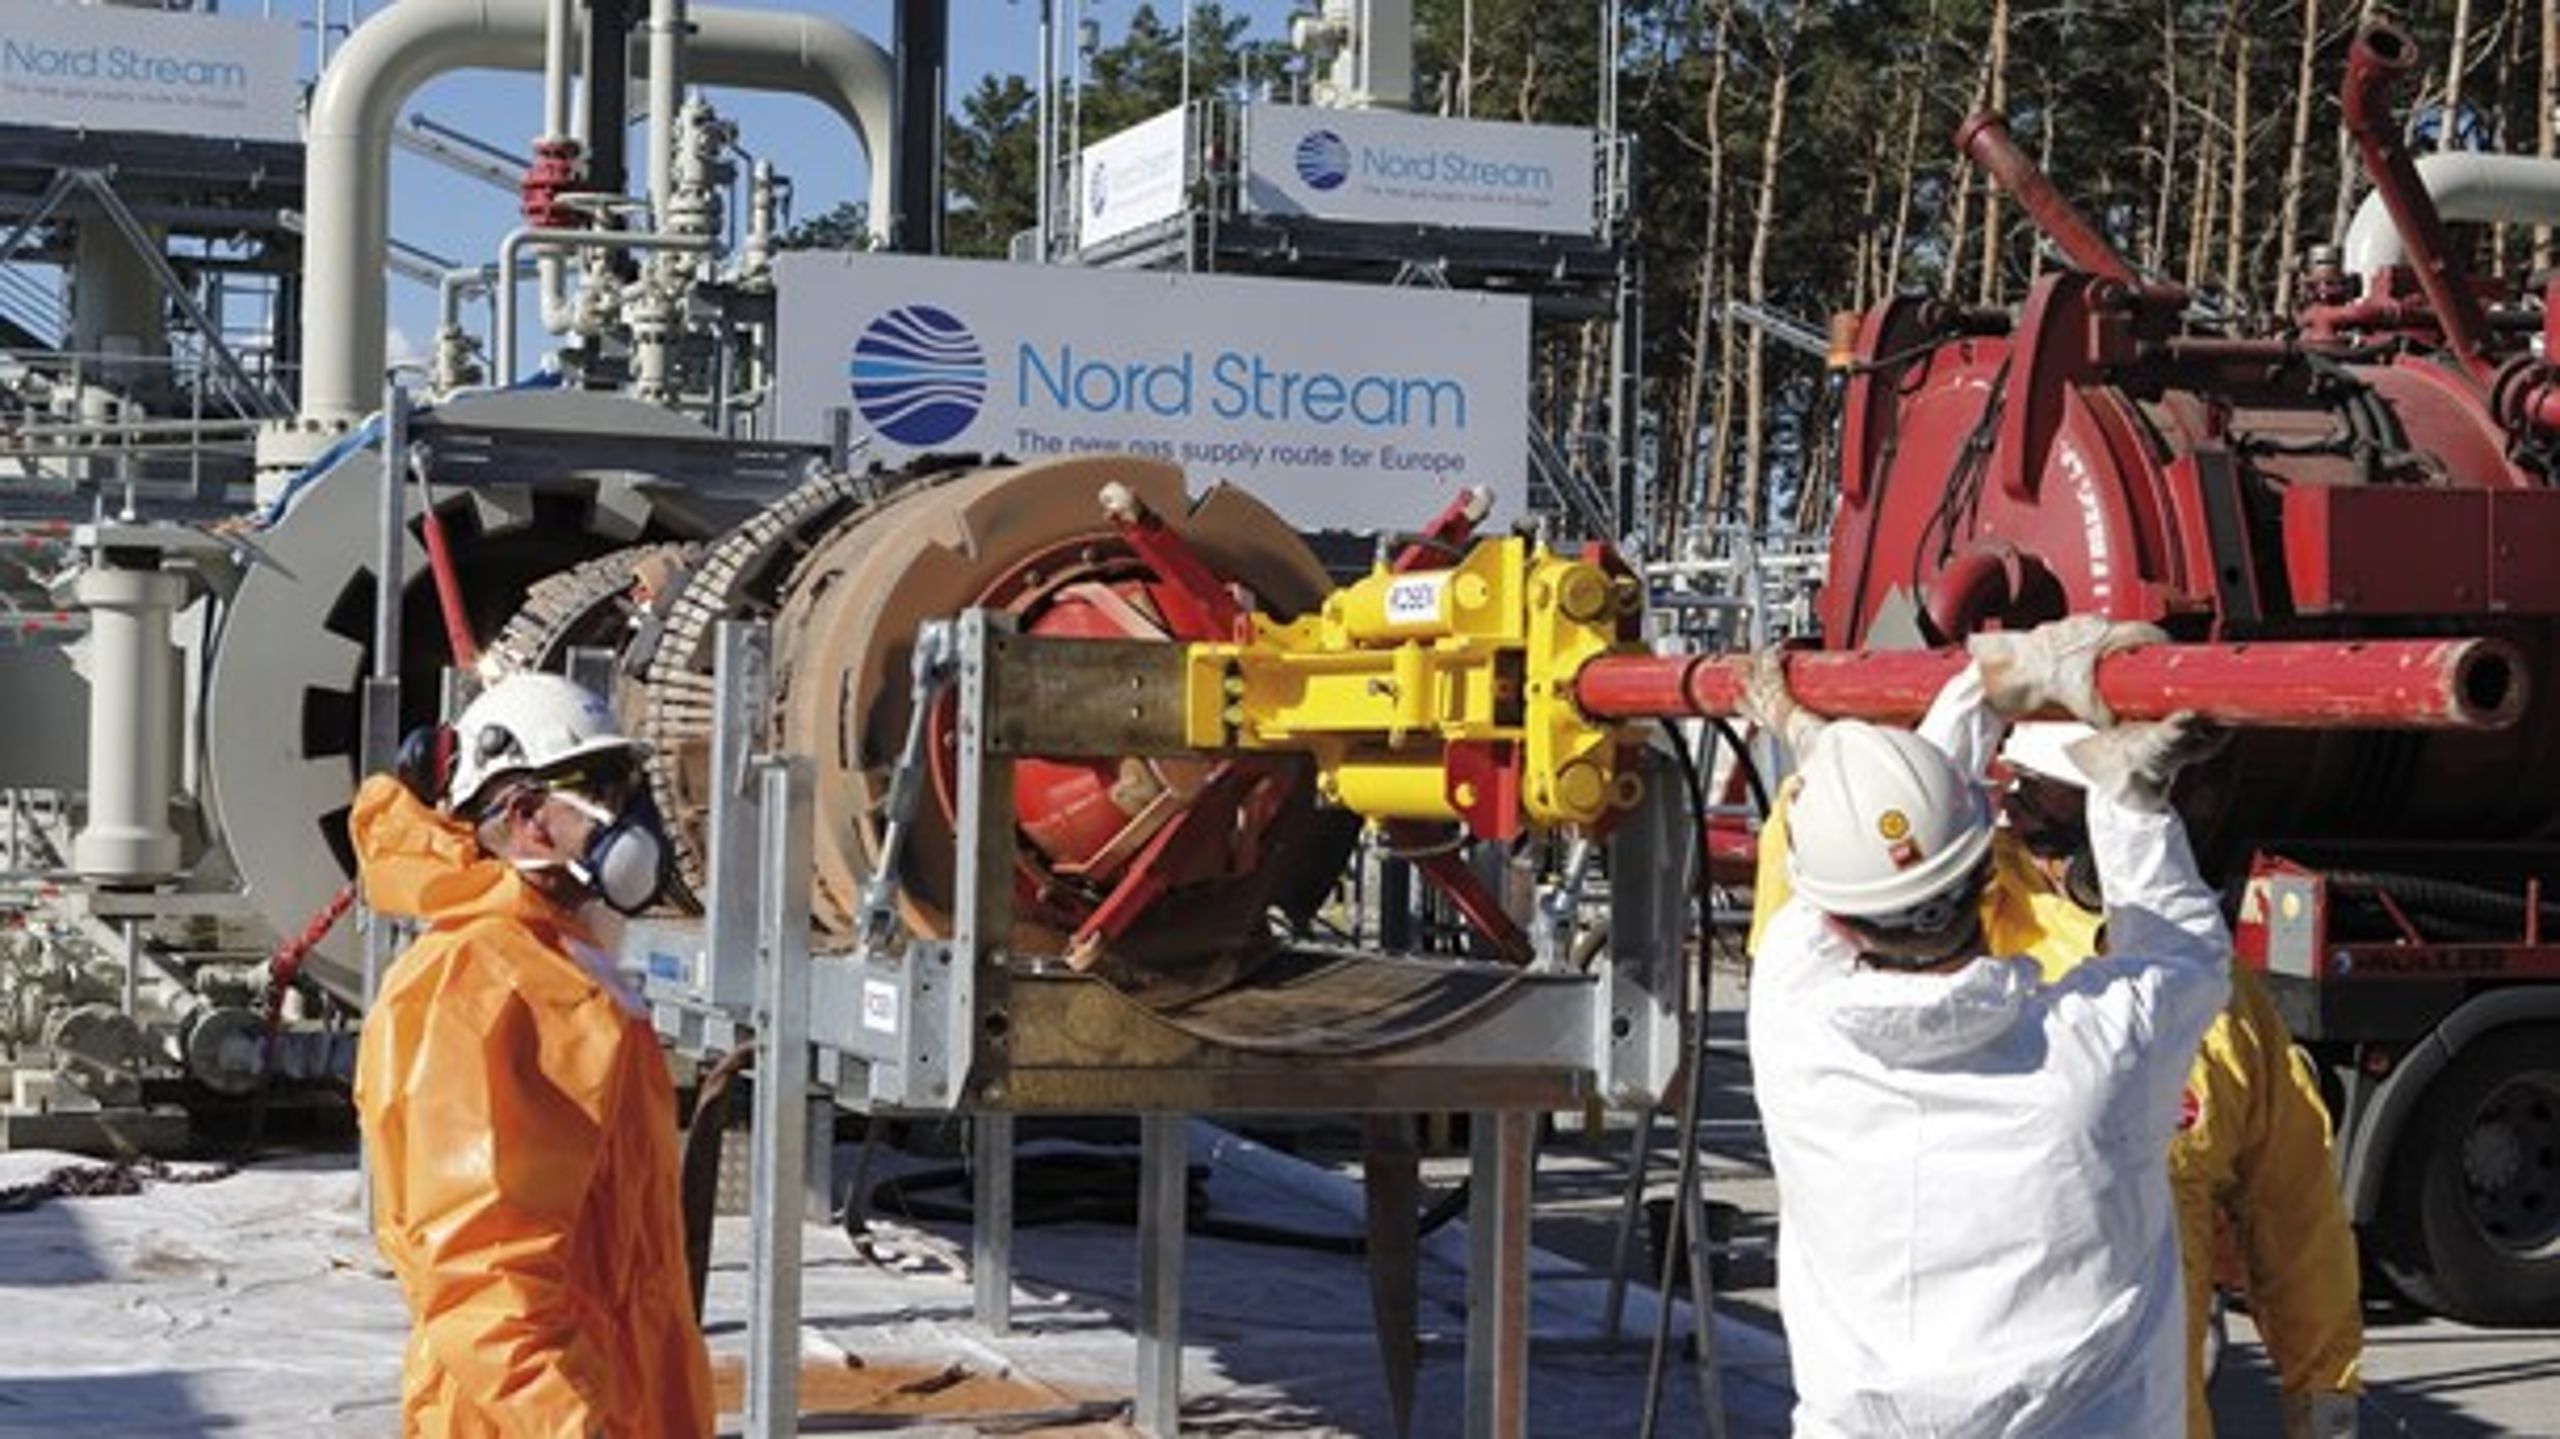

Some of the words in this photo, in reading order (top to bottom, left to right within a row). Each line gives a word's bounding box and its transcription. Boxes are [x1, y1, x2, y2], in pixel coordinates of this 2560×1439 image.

[4, 40, 97, 77] Nord
[107, 46, 246, 89] Stream
[1363, 147, 1437, 181] Nord
[1443, 153, 1553, 190] Stream
[1019, 342, 1192, 416] Nord
[1211, 352, 1466, 428] Stream
[1016, 427, 1063, 453] The
[1070, 437, 1121, 453] new
[1181, 440, 1264, 469] supply
[1270, 443, 1334, 466] route
[1341, 445, 1373, 467] for
[1380, 446, 1466, 474] Europe
